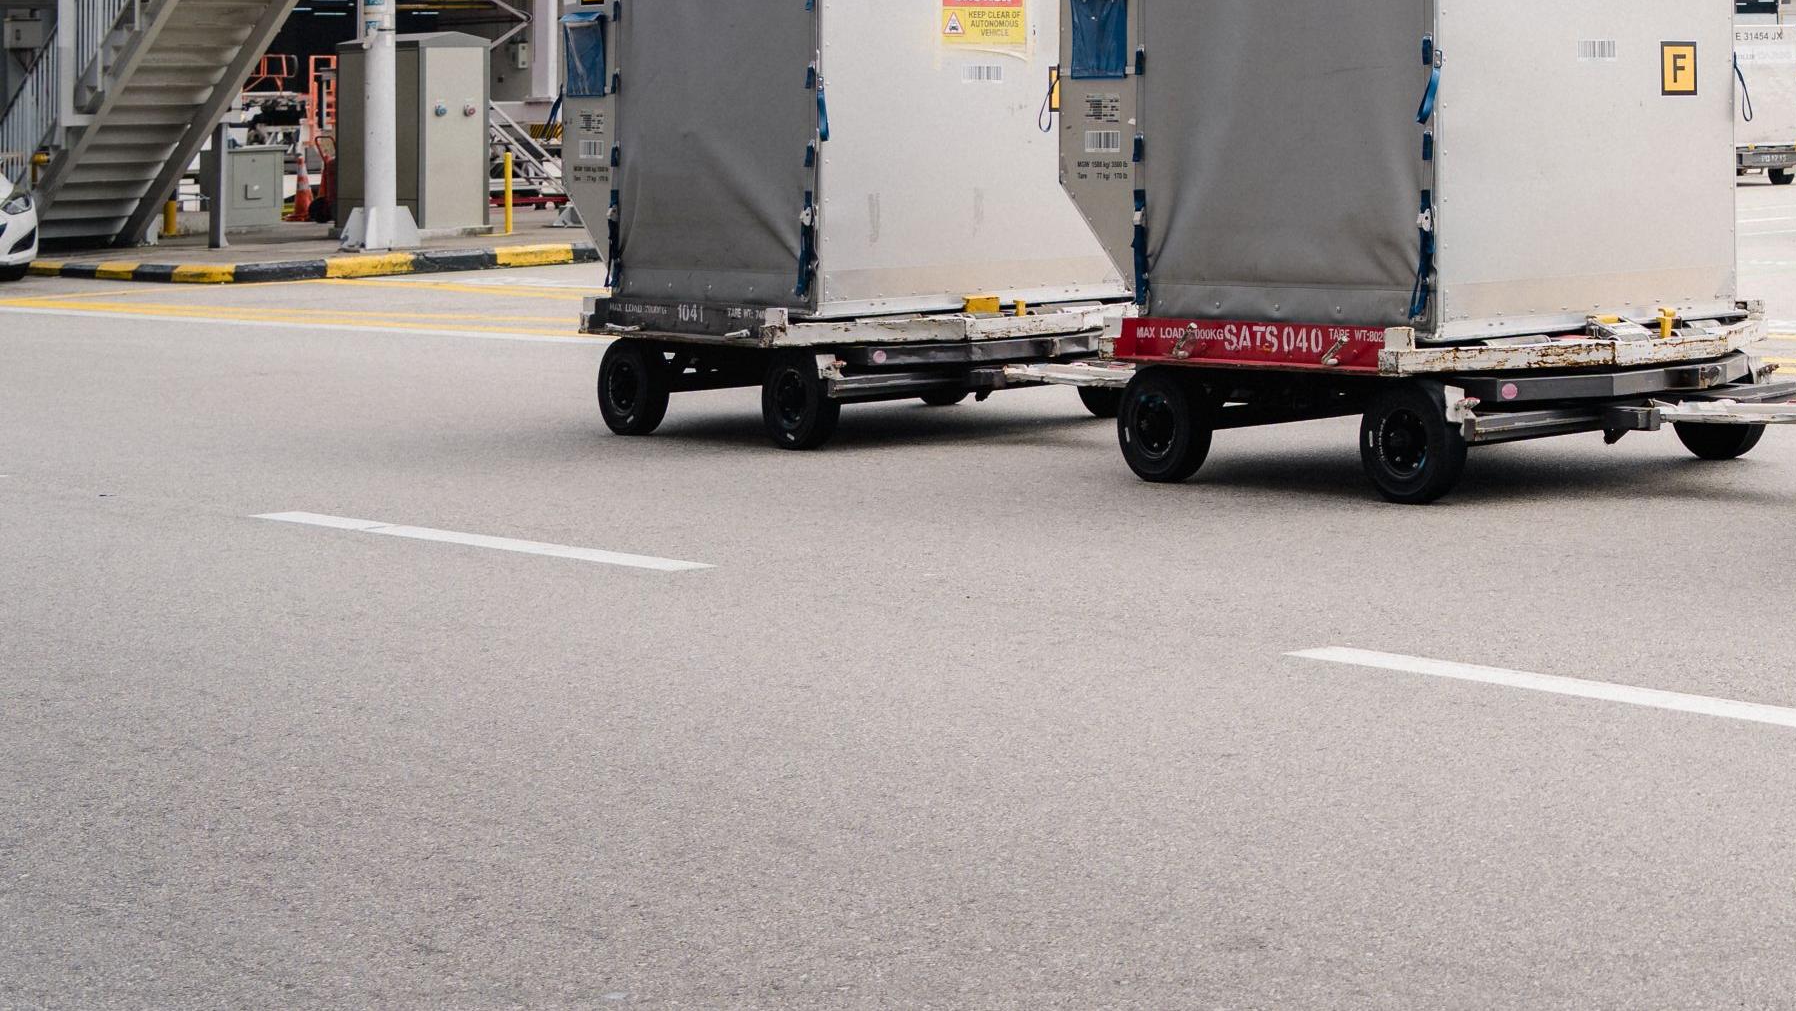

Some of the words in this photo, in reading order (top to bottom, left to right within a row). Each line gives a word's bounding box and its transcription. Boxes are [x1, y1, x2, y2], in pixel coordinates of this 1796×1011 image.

[968, 11, 987, 19] KEEP
[987, 11, 1010, 19] CLEAR
[1011, 11, 1021, 19] OF
[970, 20, 1019, 28] AUTONOMOUS
[980, 29, 1009, 37] VEHICLE
[1743, 32, 1769, 41] 31454
[1771, 31, 1783, 40] JX
[1672, 54, 1686, 83] F
[1136, 326, 1156, 339] MAX
[1160, 327, 1185, 339] LOAD
[1328, 328, 1351, 341] TARE
[1224, 324, 1279, 353] SATS
[1282, 326, 1323, 353] 040
